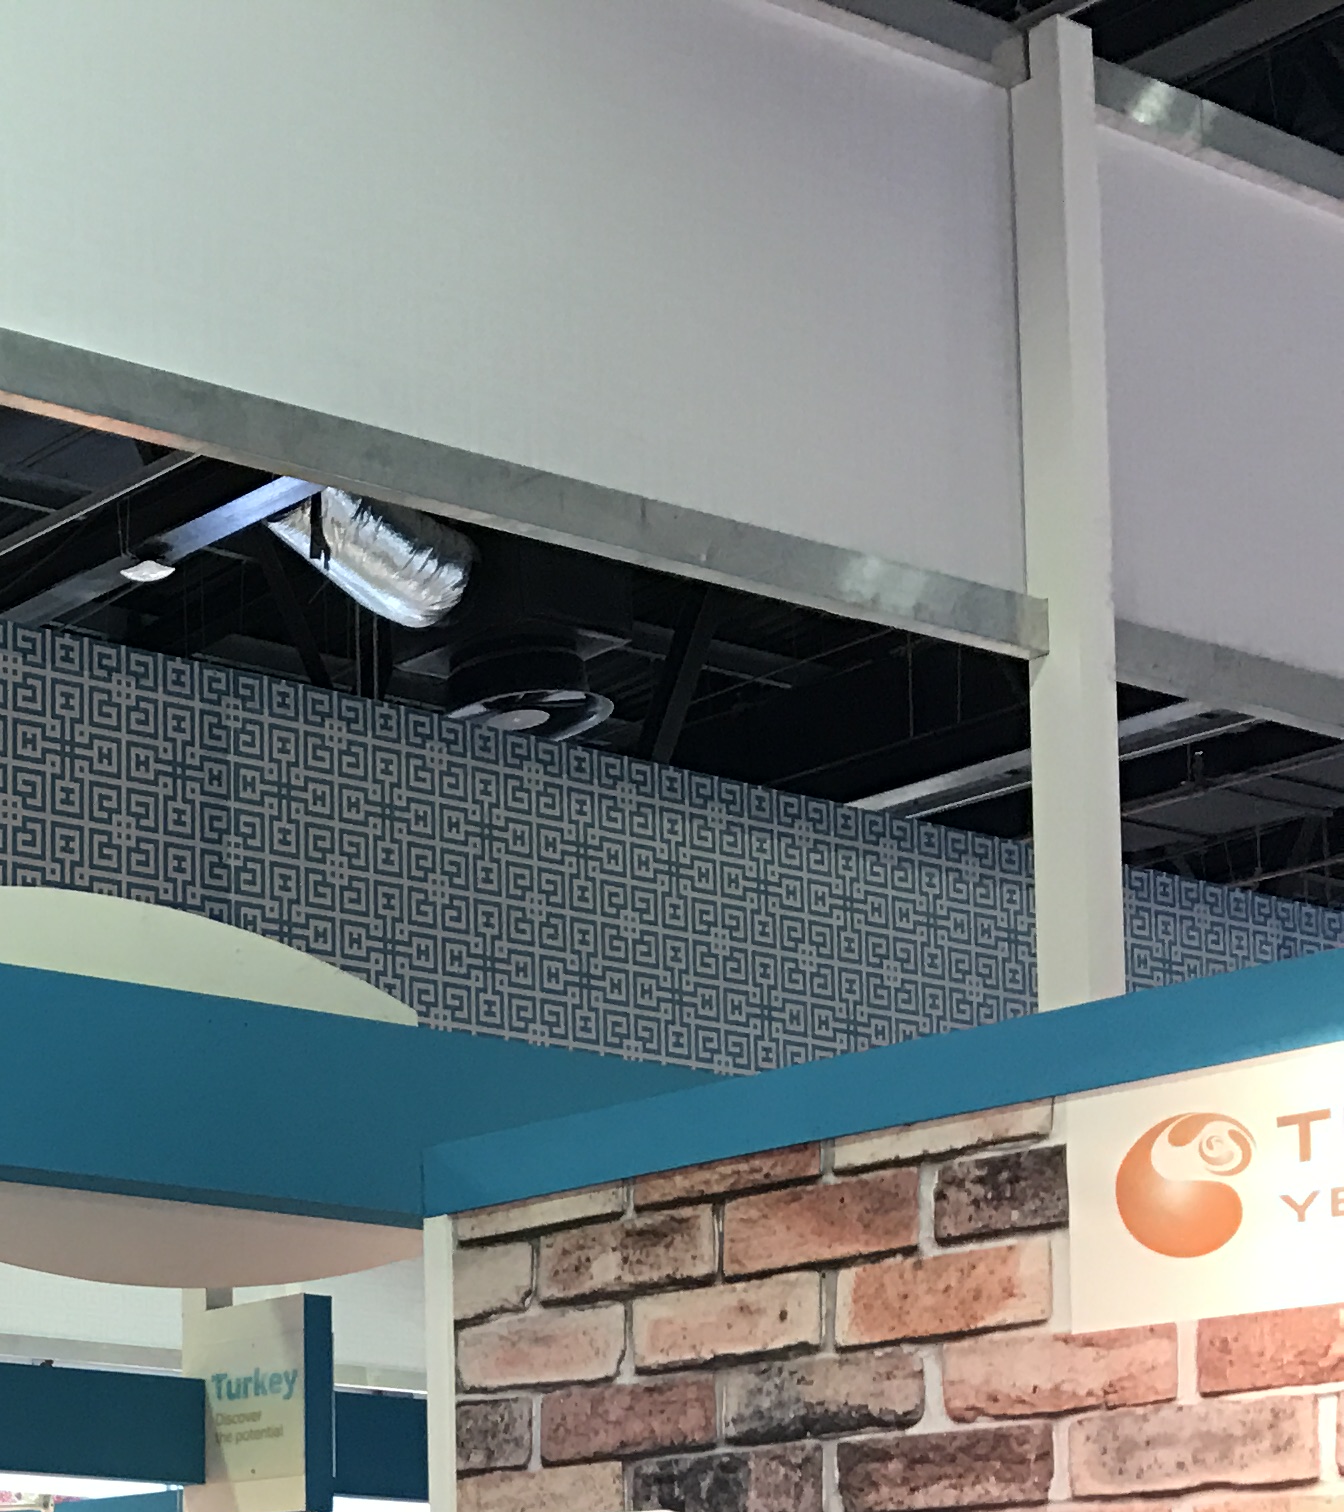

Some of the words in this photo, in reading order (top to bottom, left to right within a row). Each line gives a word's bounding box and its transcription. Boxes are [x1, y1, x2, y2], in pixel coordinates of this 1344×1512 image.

[212, 1367, 298, 1401] Turkey
[215, 1409, 263, 1427] Discover
[235, 1424, 284, 1445] potential
